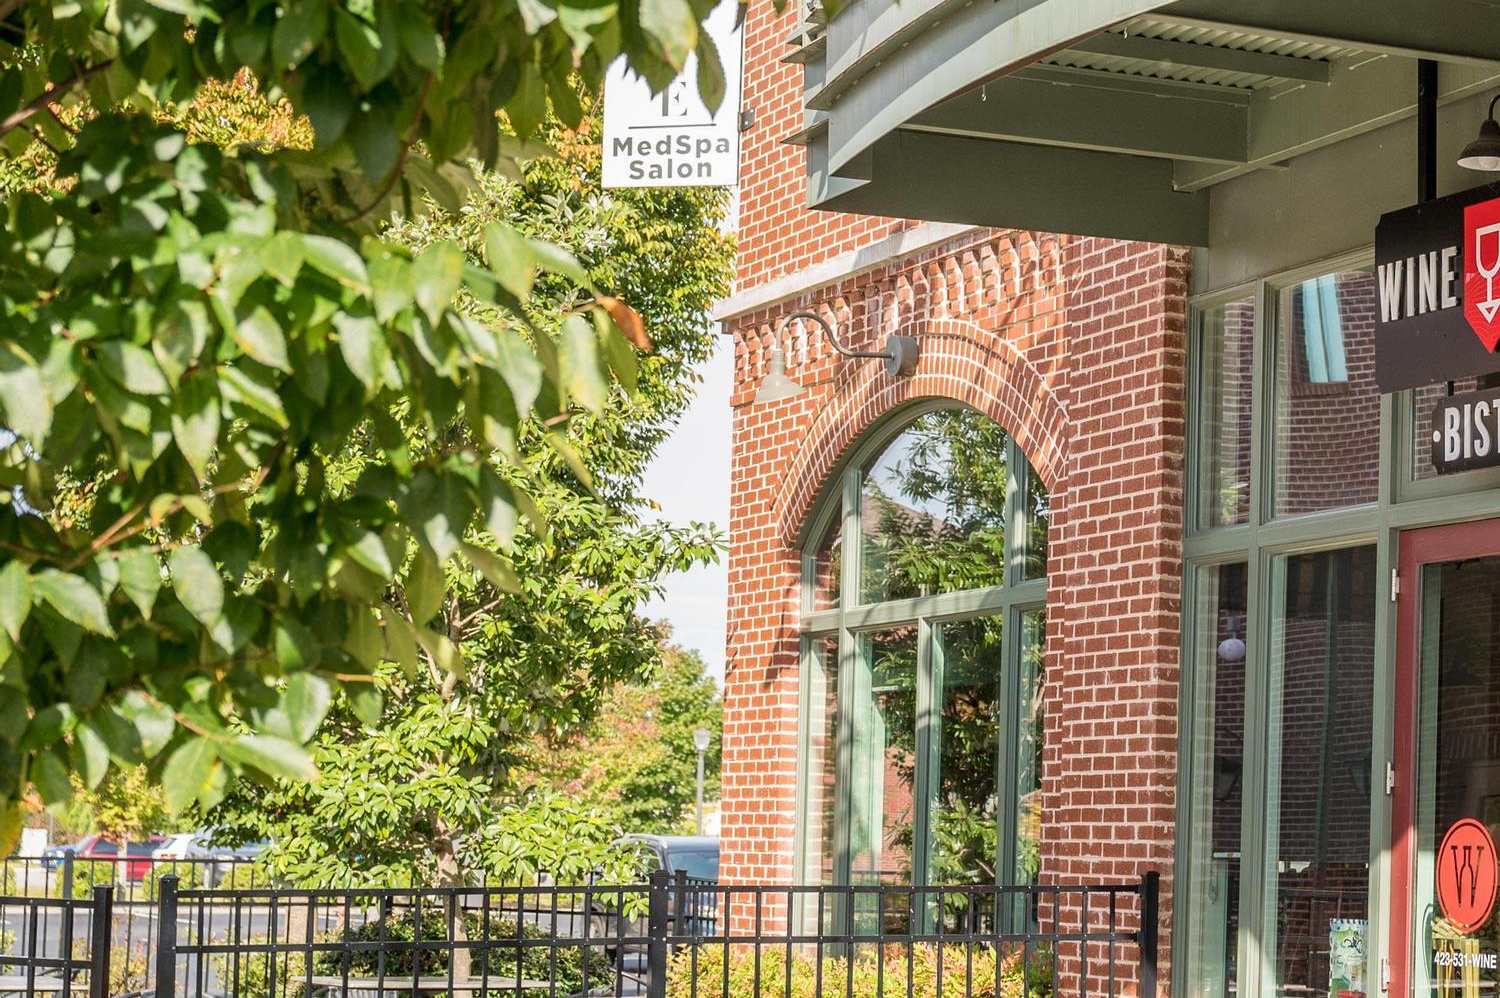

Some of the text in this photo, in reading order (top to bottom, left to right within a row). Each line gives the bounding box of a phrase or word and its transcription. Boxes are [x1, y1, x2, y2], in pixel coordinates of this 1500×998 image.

[612, 134, 731, 158] MedSpa
[628, 158, 712, 180] Salon
[1377, 246, 1458, 323] WINE
